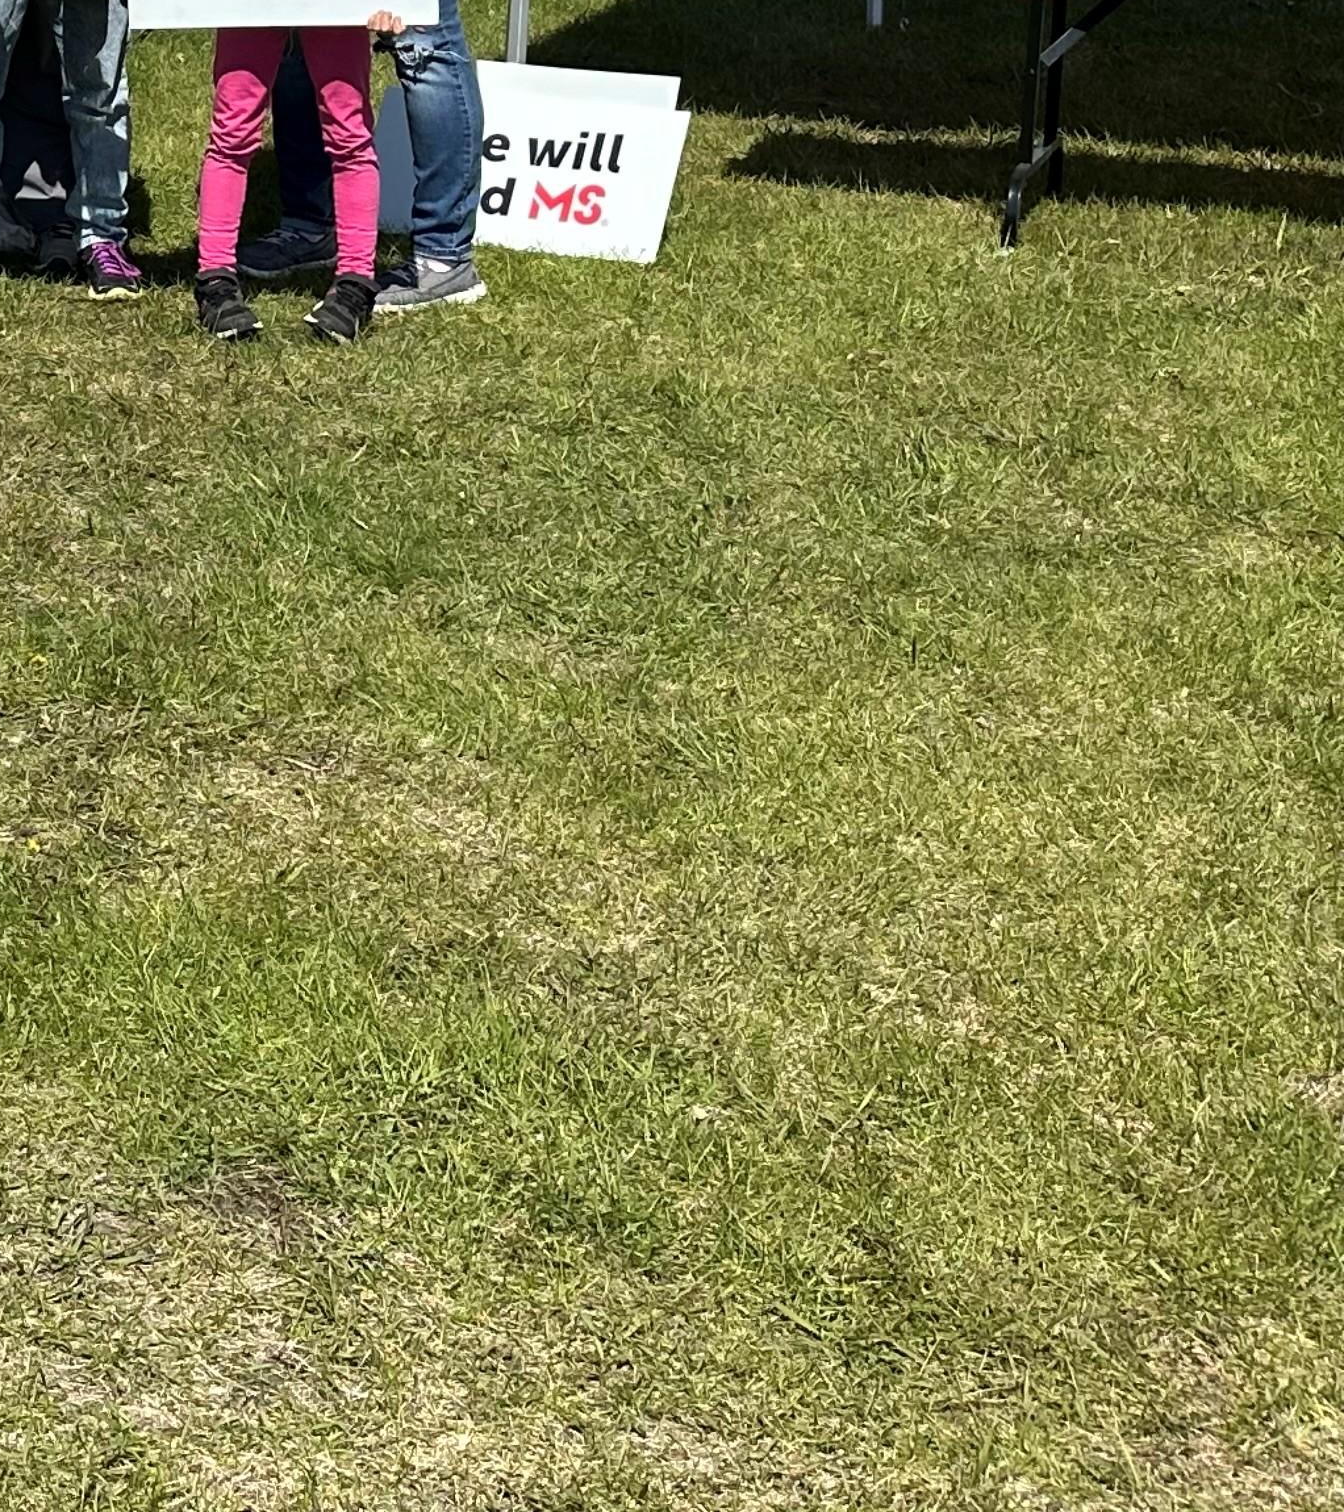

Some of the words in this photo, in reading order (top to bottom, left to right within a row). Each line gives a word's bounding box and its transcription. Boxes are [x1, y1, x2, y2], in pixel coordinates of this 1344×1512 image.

[480, 135, 511, 164] e
[527, 133, 626, 174] will
[527, 180, 606, 226] MS
